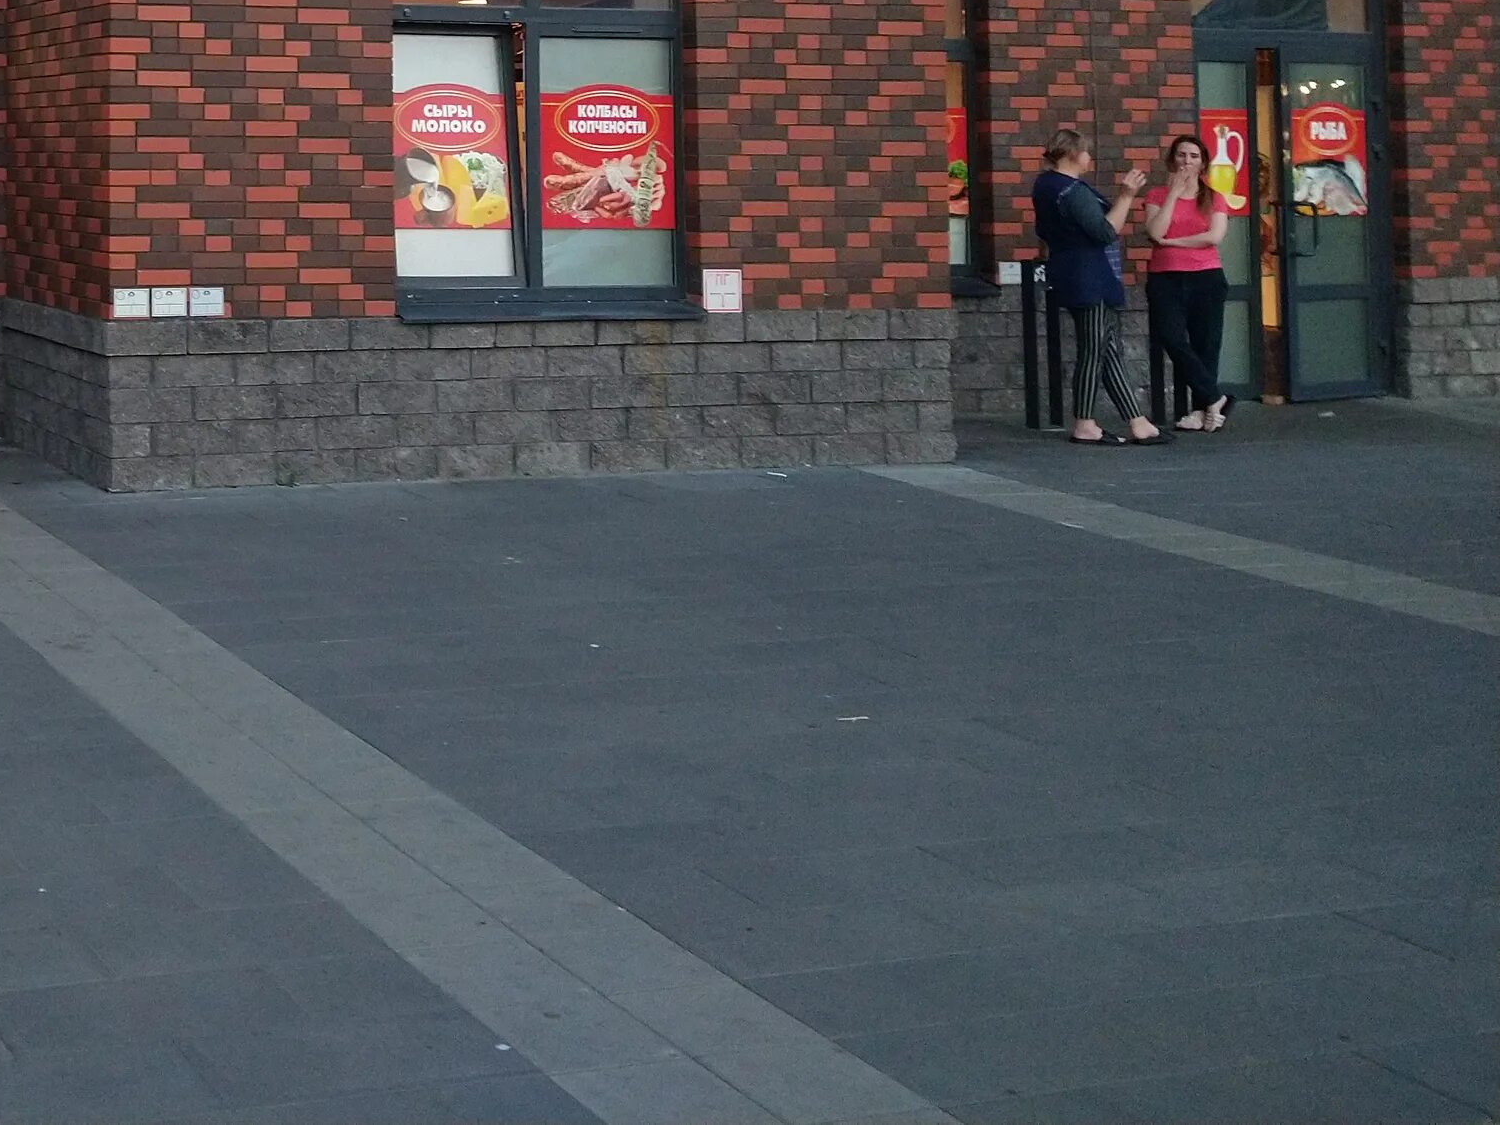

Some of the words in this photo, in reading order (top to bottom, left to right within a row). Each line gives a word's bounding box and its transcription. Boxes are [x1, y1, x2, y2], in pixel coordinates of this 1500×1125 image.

[423, 104, 473, 118] СЫРЫ
[577, 104, 638, 118] КОЛБАСЫ
[411, 119, 487, 133] МОЛОКО
[568, 120, 647, 134] КОПЧЕНОСТИ
[1309, 120, 1349, 141] РЫБА
